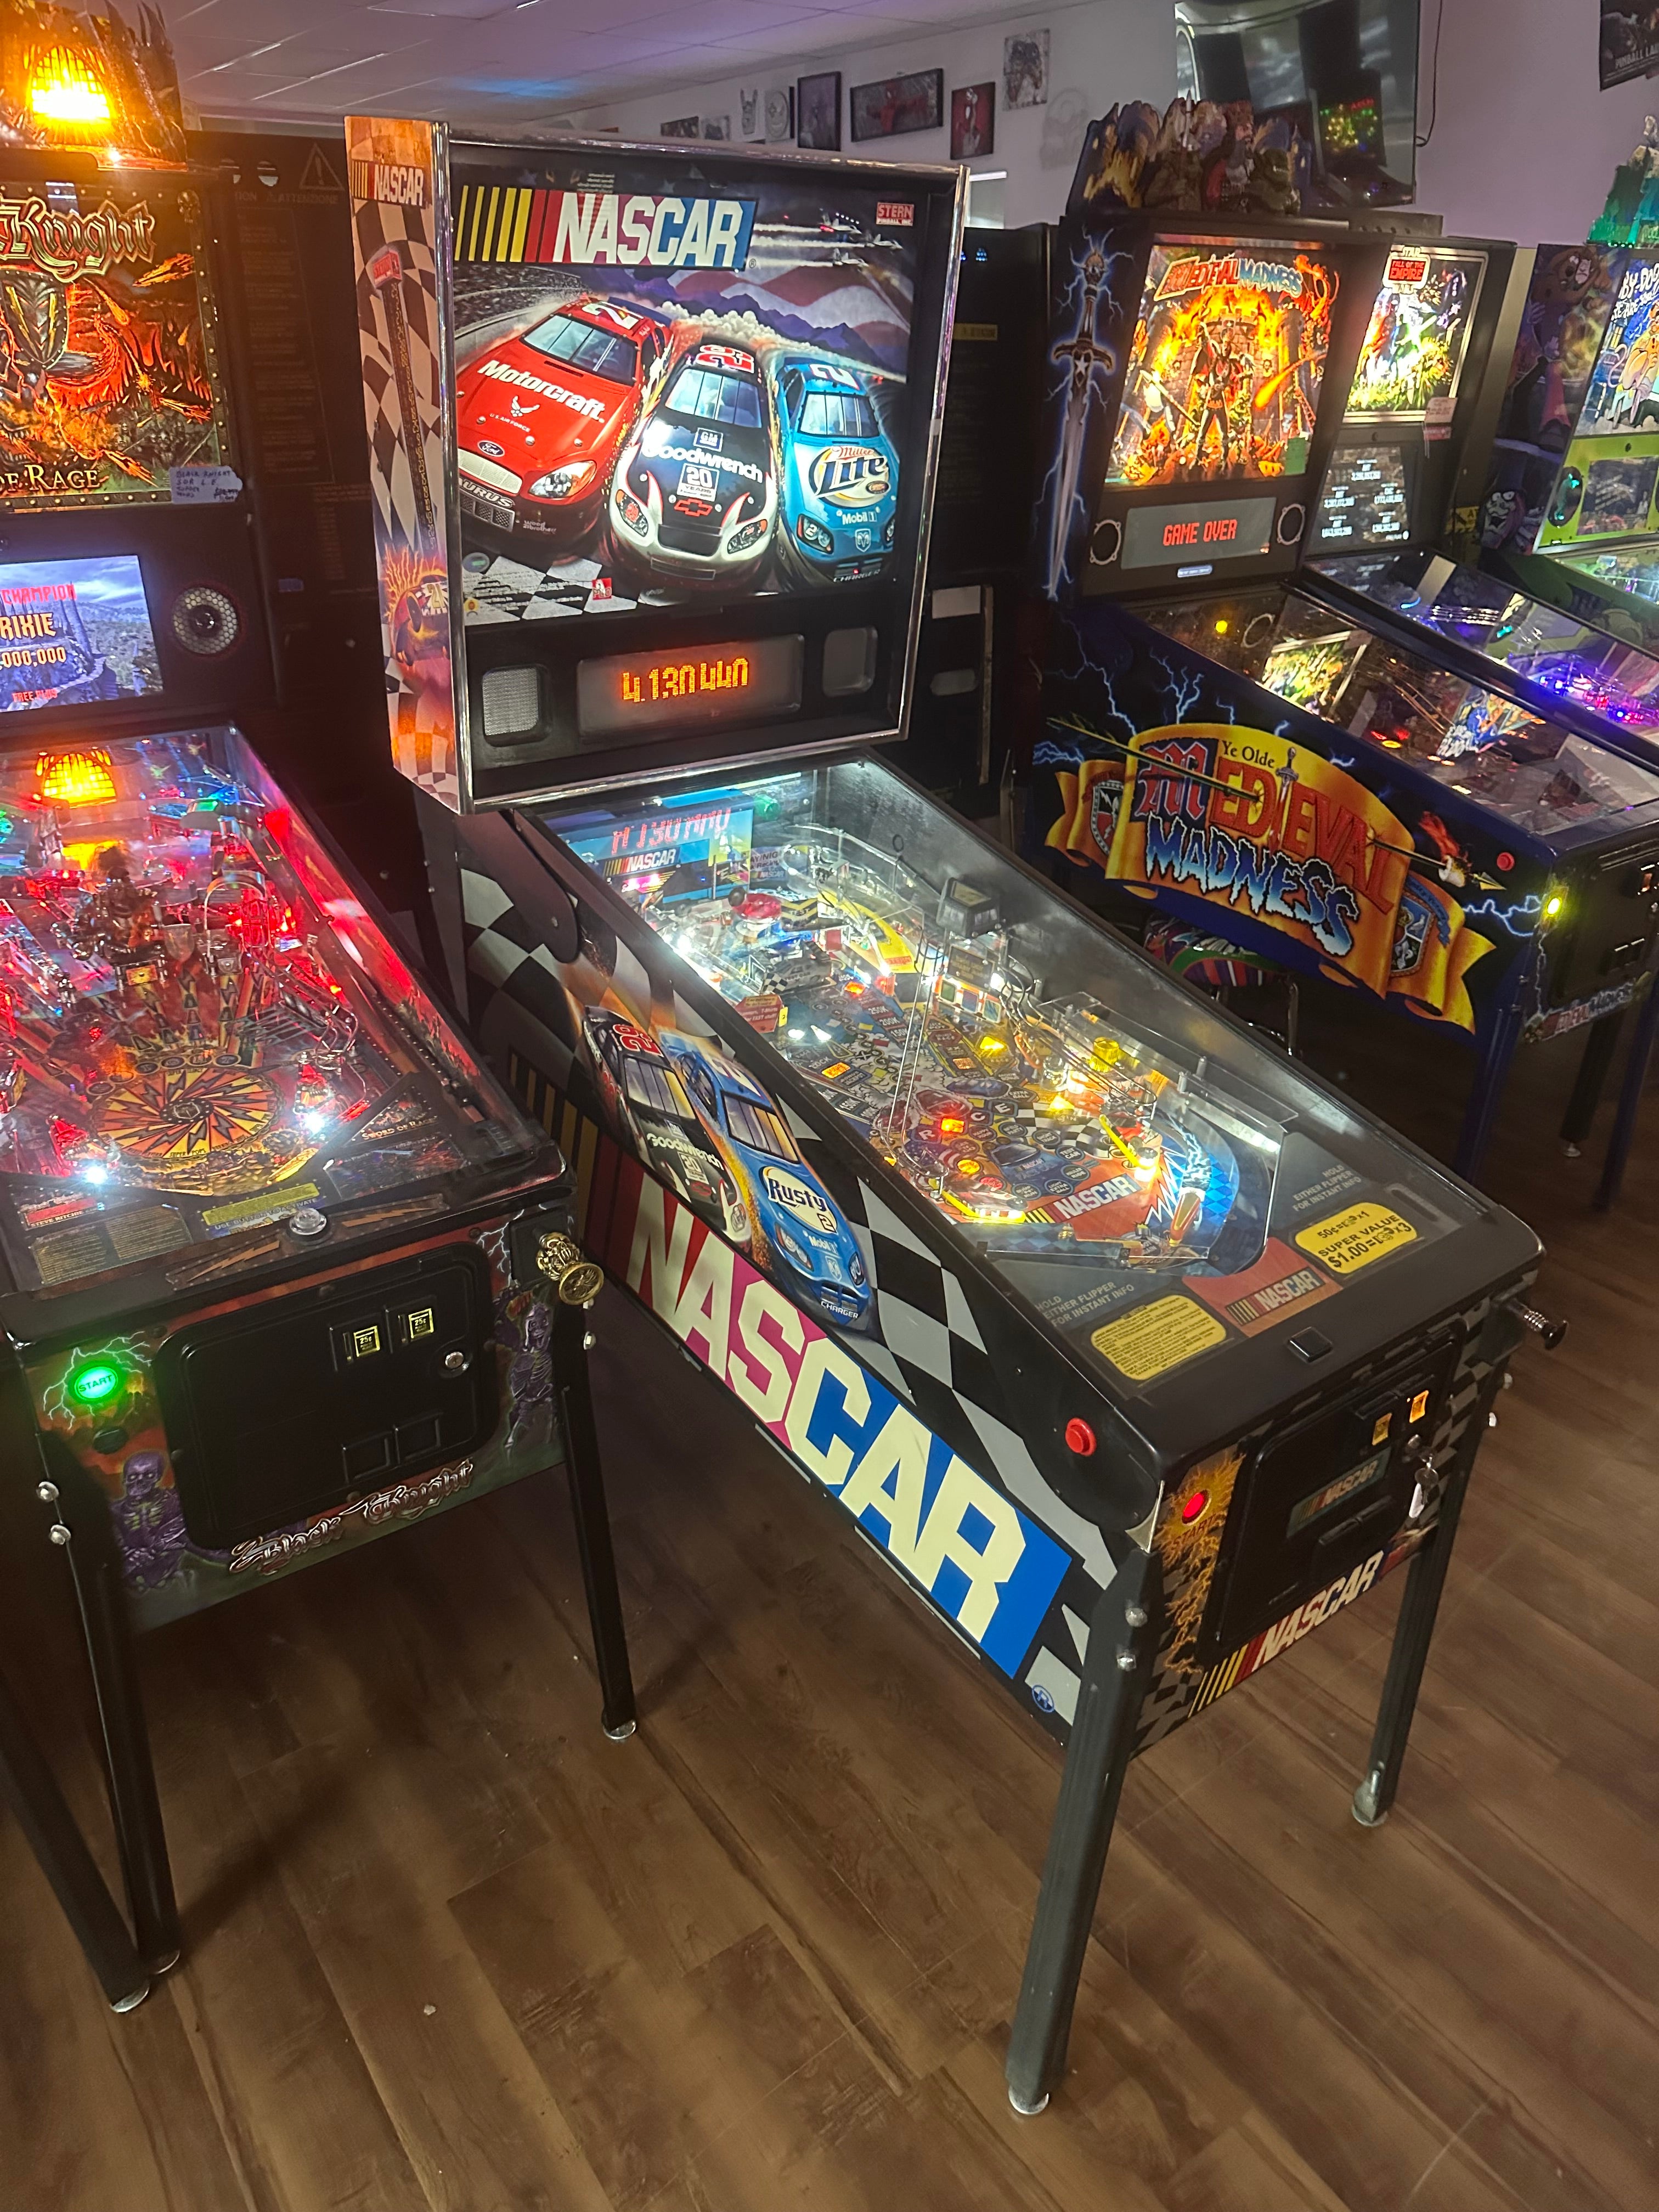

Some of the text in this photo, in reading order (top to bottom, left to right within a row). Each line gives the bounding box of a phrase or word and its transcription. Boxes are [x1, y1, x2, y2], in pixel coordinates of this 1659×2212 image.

[374, 164, 424, 206] NASCAR
[878, 204, 912, 218] STERN
[552, 192, 743, 269] NASCAR
[1238, 258, 1303, 298] MADNESS
[1389, 267, 1424, 280] EMPIRE
[809, 363, 860, 391] 2
[510, 420, 531, 433] FORCE
[482, 442, 500, 455] Ford
[832, 445, 874, 459] Miller
[25, 464, 101, 492] RAGE
[686, 466, 713, 488] 20
[815, 455, 889, 496] Lite
[842, 512, 868, 525] Mobil
[1163, 519, 1238, 546] GAME OVER
[1221, 740, 1276, 768] Ye Olde
[1133, 739, 1395, 916] MEDIEVAL
[628, 848, 676, 872] NASCAR
[1145, 812, 1361, 958] MADNESS
[970, 1112, 985, 1121] C
[994, 1102, 1011, 1113] E
[362, 1128, 395, 1141] SWORD
[918, 1130, 935, 1141] R
[1064, 1151, 1081, 1160] CAR
[1322, 1164, 1345, 1178] HOLD
[768, 1178, 827, 1212] Rusty
[1053, 1176, 1137, 1219] NASCAR
[1293, 1170, 1353, 1201] EITHER FLIPPER
[1293, 1176, 1361, 1212] FOR INSTANT INFO
[31, 1217, 54, 1228] STEVE
[817, 1213, 837, 1234] 2
[1318, 1215, 1400, 1257] SUPER VALUE
[1035, 1295, 1062, 1312] HOLD
[1042, 1281, 1117, 1319] EITHER FLIPPER
[1255, 1271, 1320, 1312] NASCAR
[820, 1300, 859, 1319] CHARGER
[1051, 1284, 1135, 1328] FOR INSTANT INFO
[78, 1374, 112, 1392] START
[625, 1172, 1026, 1643] NASCAR
[1321, 1459, 1380, 1505] NASCAR
[1252, 1551, 1384, 1671] NASCAR
